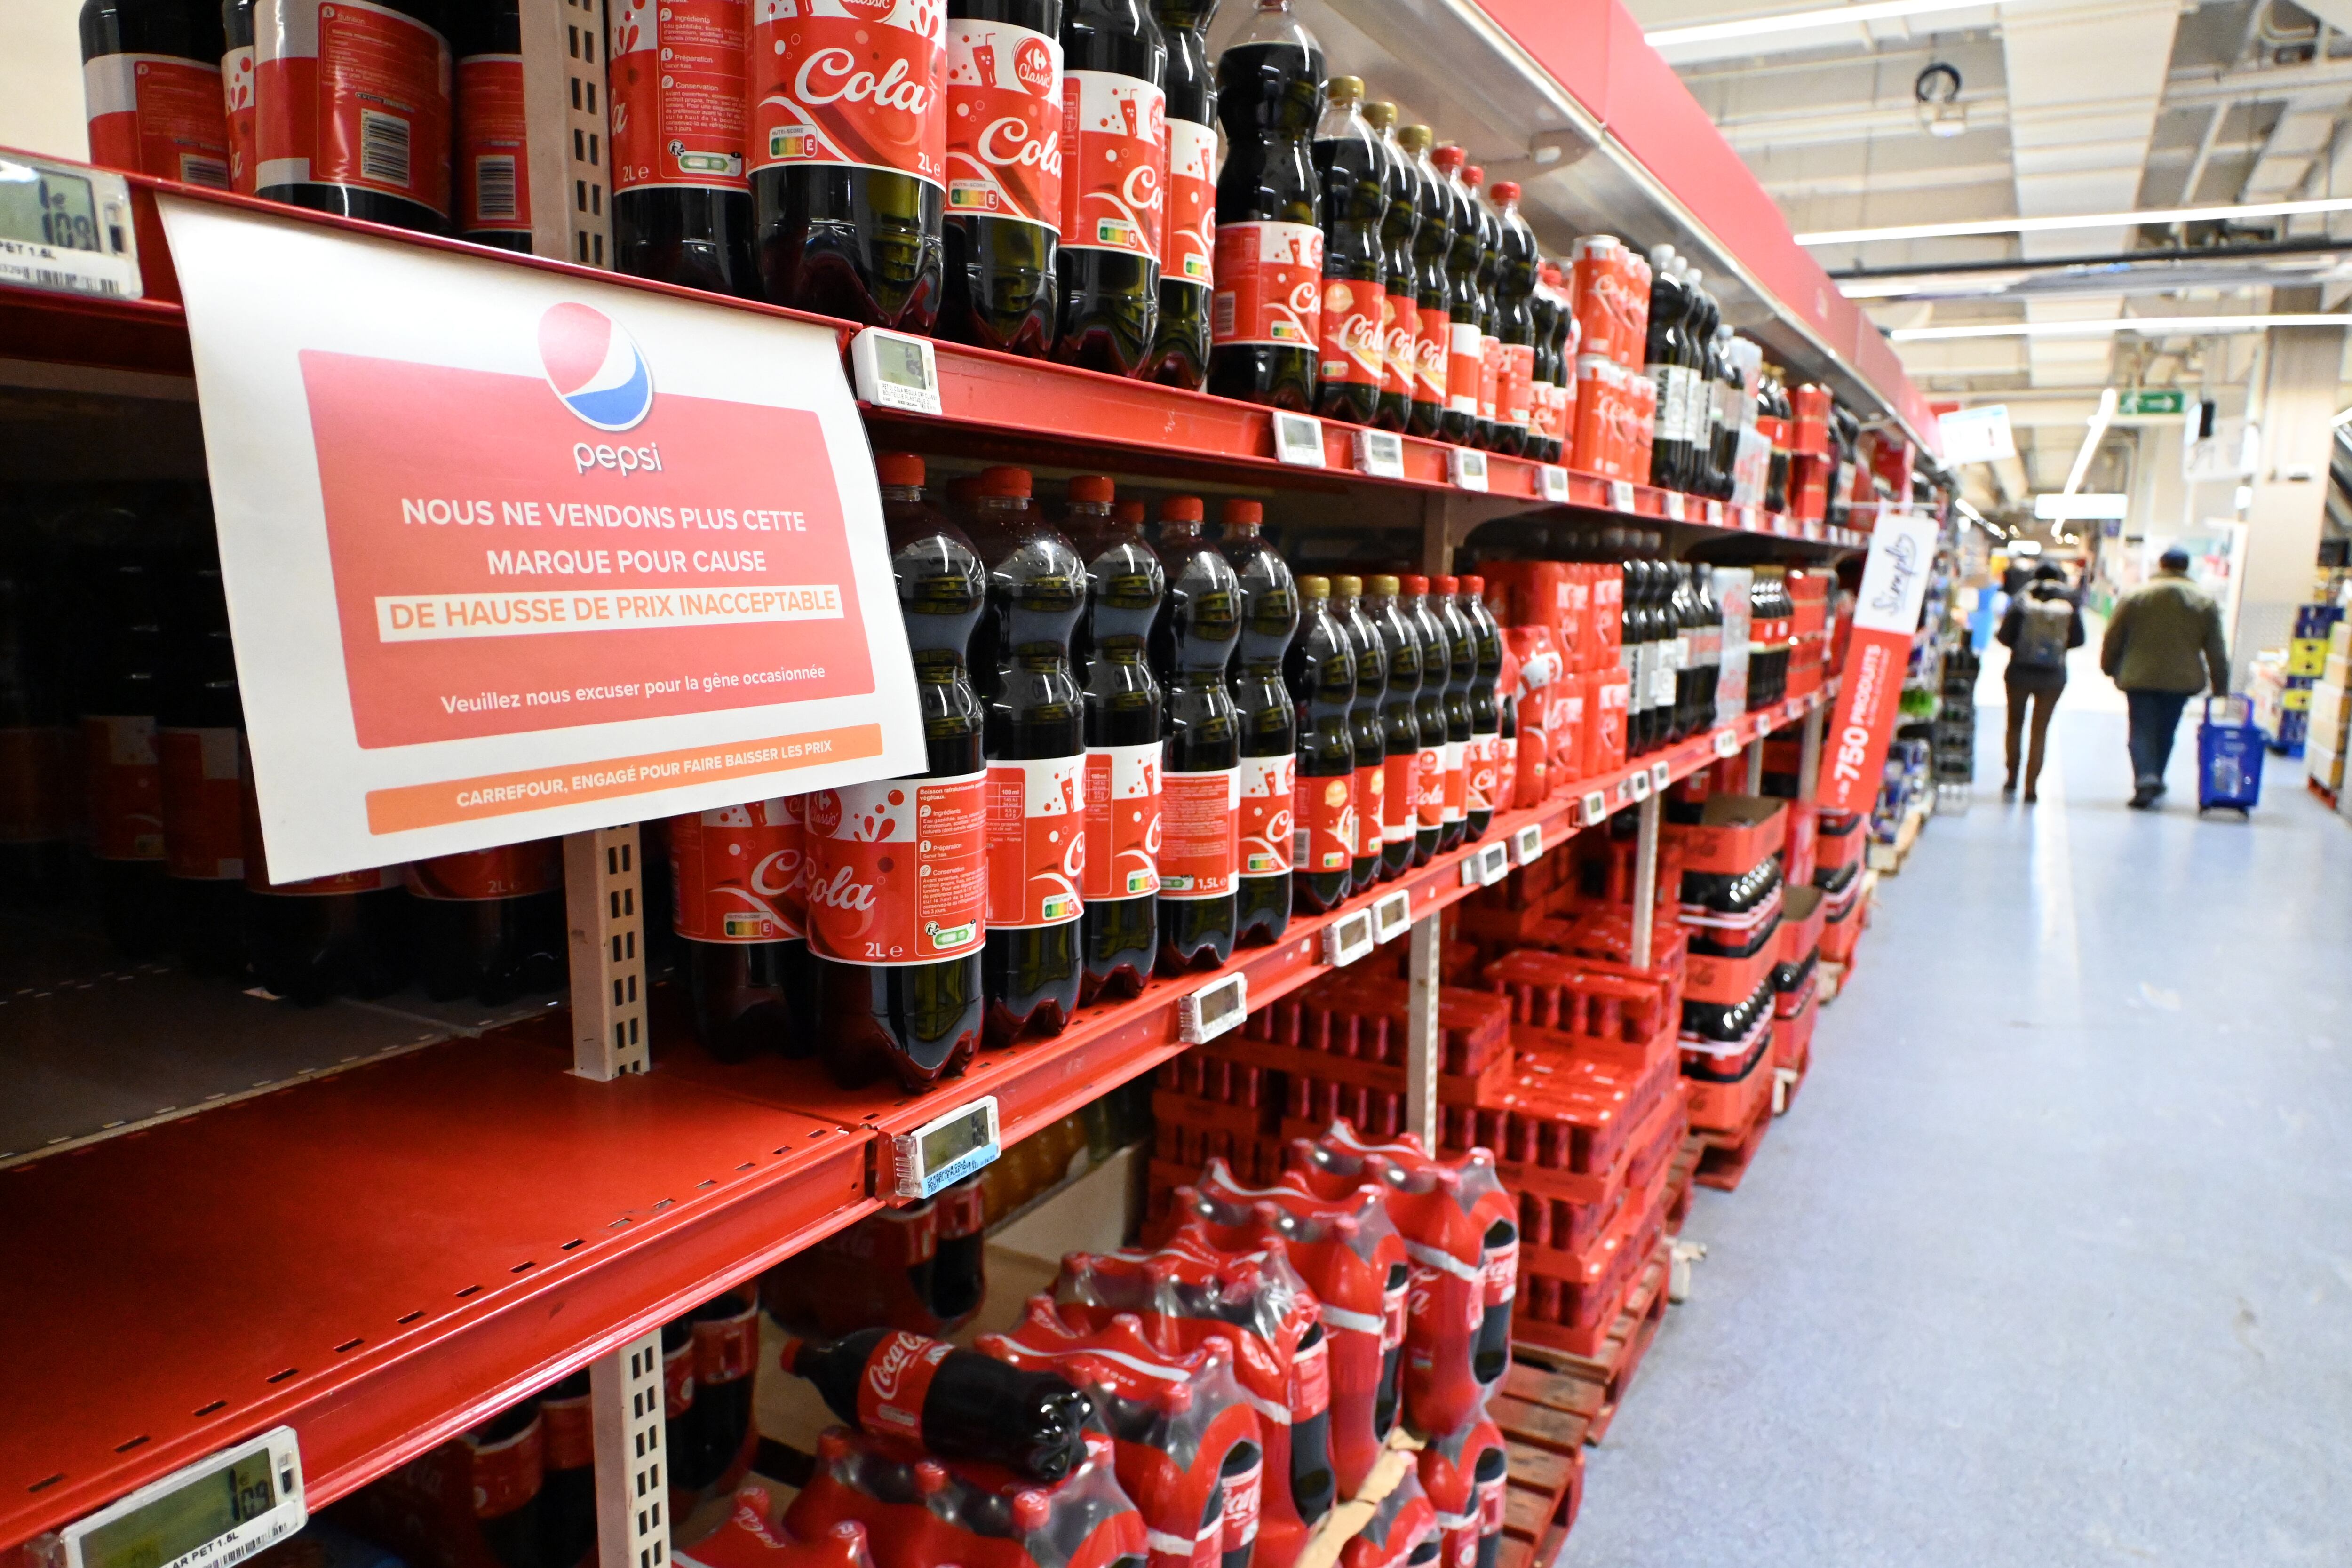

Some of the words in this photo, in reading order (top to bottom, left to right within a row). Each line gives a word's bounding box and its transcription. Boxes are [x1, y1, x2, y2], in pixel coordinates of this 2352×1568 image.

[675, 54, 713, 63] Préparation
[795, 48, 928, 114] Cola
[1018, 63, 1052, 88] Classic
[676, 82, 718, 91] Conservation
[807, 139, 813, 151] E
[917, 152, 932, 173] 2L
[623, 165, 636, 182] 2L
[988, 194, 995, 204] E
[573, 442, 662, 476] pepsi
[401, 498, 495, 525] NOUS
[501, 501, 542, 526] NE
[546, 503, 675, 529] VENDONS
[680, 508, 738, 530] PLUS
[742, 509, 806, 531] CETTE
[486, 550, 612, 575] MARQUE
[617, 550, 688, 573] POUR
[693, 550, 767, 572] CAUSE
[390, 603, 436, 629] DE
[445, 598, 566, 627] HAUSSE
[573, 597, 610, 621] DE
[616, 595, 675, 619] PRIX
[679, 590, 836, 616] INACCEPTABLE
[440, 692, 521, 714] Veuillez
[526, 689, 571, 706] nous
[575, 684, 640, 700] excuser
[645, 679, 681, 698] pour
[685, 675, 699, 691] la
[703, 672, 739, 693] gêne
[743, 664, 826, 685] occasionnée
[1833, 726, 1869, 781] 750
[456, 779, 568, 807] CARREFOUR,
[572, 765, 636, 790] ENGAGÉ
[640, 762, 680, 780] POUR
[684, 756, 723, 773] FAIRE
[725, 748, 779, 767] BAISSER
[781, 745, 803, 758] LES
[805, 740, 833, 755] PRIX
[933, 808, 961, 817] Ingrédients
[933, 843, 962, 852] Préparation
[933, 867, 965, 876] Conservation
[488, 880, 506, 893] 2L
[1198, 877, 1219, 890] 1,5L
[763, 923, 770, 932] E
[865, 942, 885, 957] 2L
[927, 1166, 953, 1183] CARREFOUR
[954, 1159, 966, 1169] COLA
[192, 1543, 214, 1561] PET
